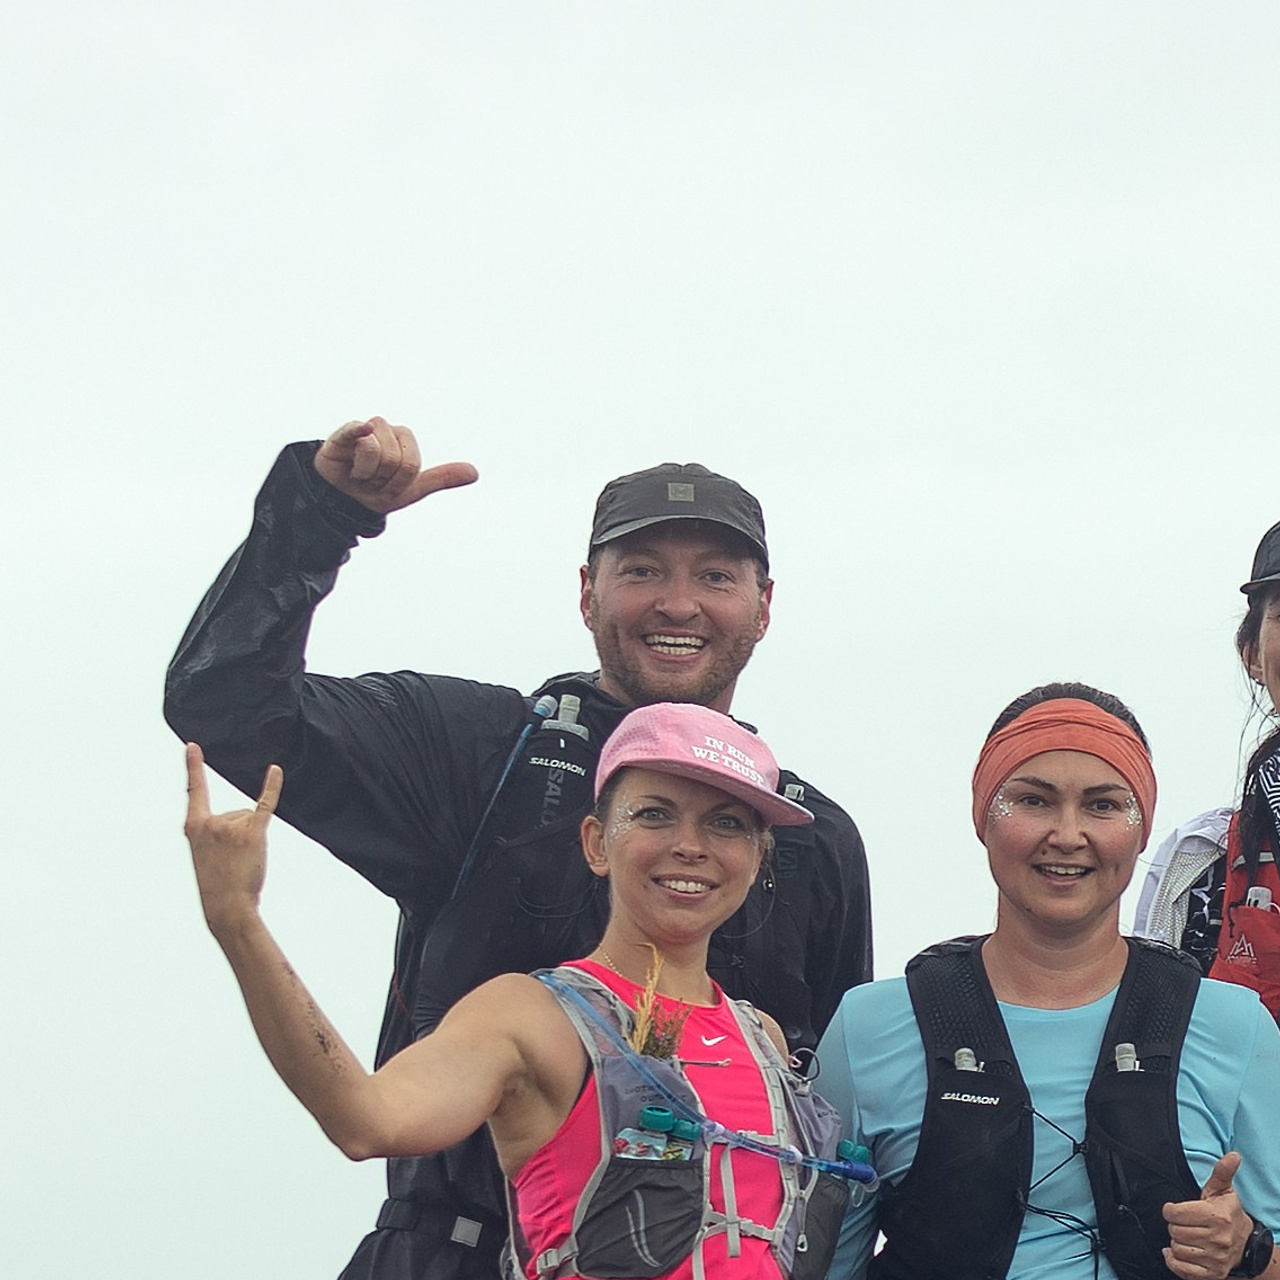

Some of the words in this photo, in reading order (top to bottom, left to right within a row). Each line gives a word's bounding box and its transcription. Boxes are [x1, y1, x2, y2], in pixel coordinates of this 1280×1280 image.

[704, 735, 725, 751] IN
[529, 757, 587, 777] SALOMON
[691, 746, 720, 763] WE
[721, 755, 764, 787] TRUST
[941, 1092, 1000, 1105] SALOMON
